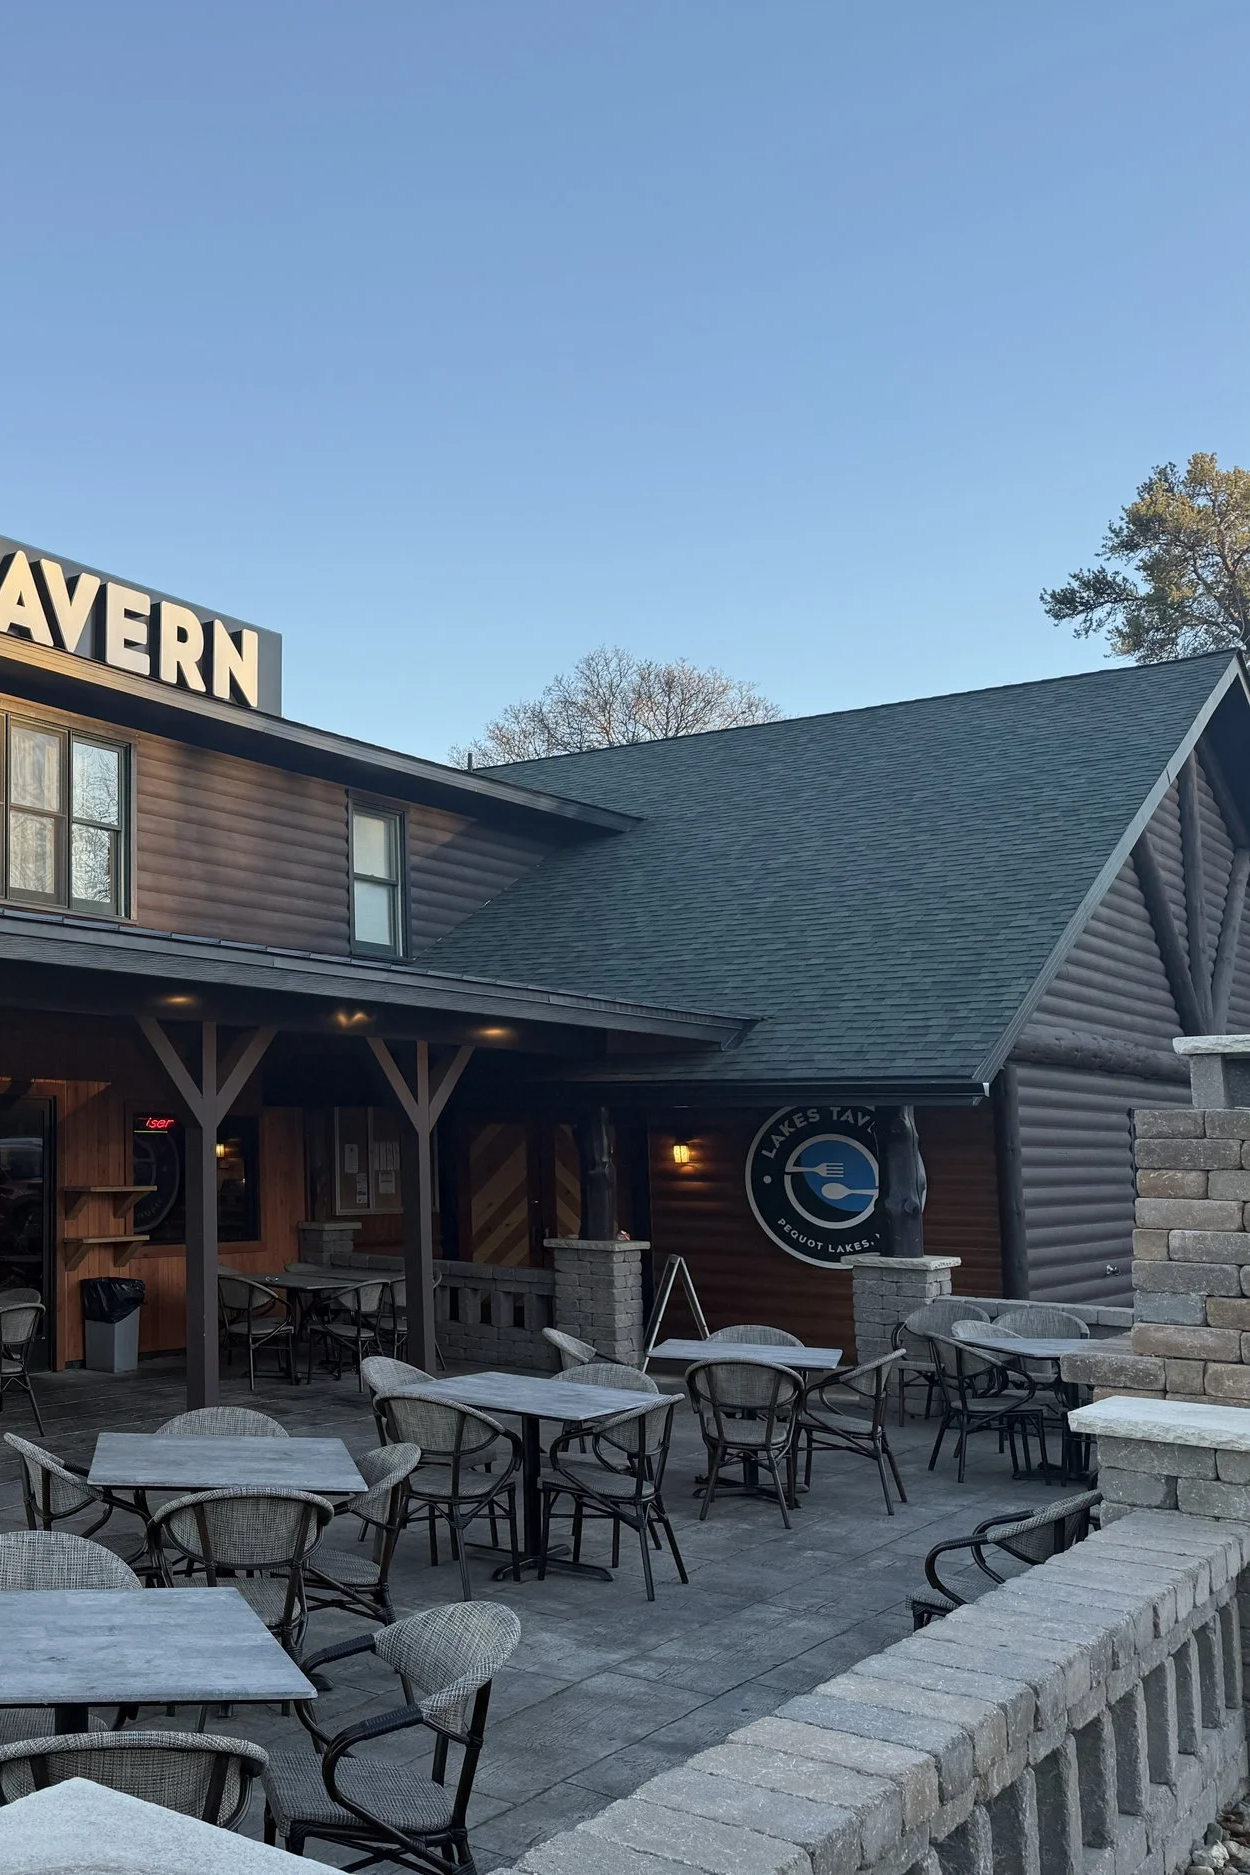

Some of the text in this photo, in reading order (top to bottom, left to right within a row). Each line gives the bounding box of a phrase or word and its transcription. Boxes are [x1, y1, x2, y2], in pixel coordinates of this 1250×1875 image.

[762, 1106, 876, 1159] LAKES TAV
[778, 1218, 823, 1250] PEQUOT
